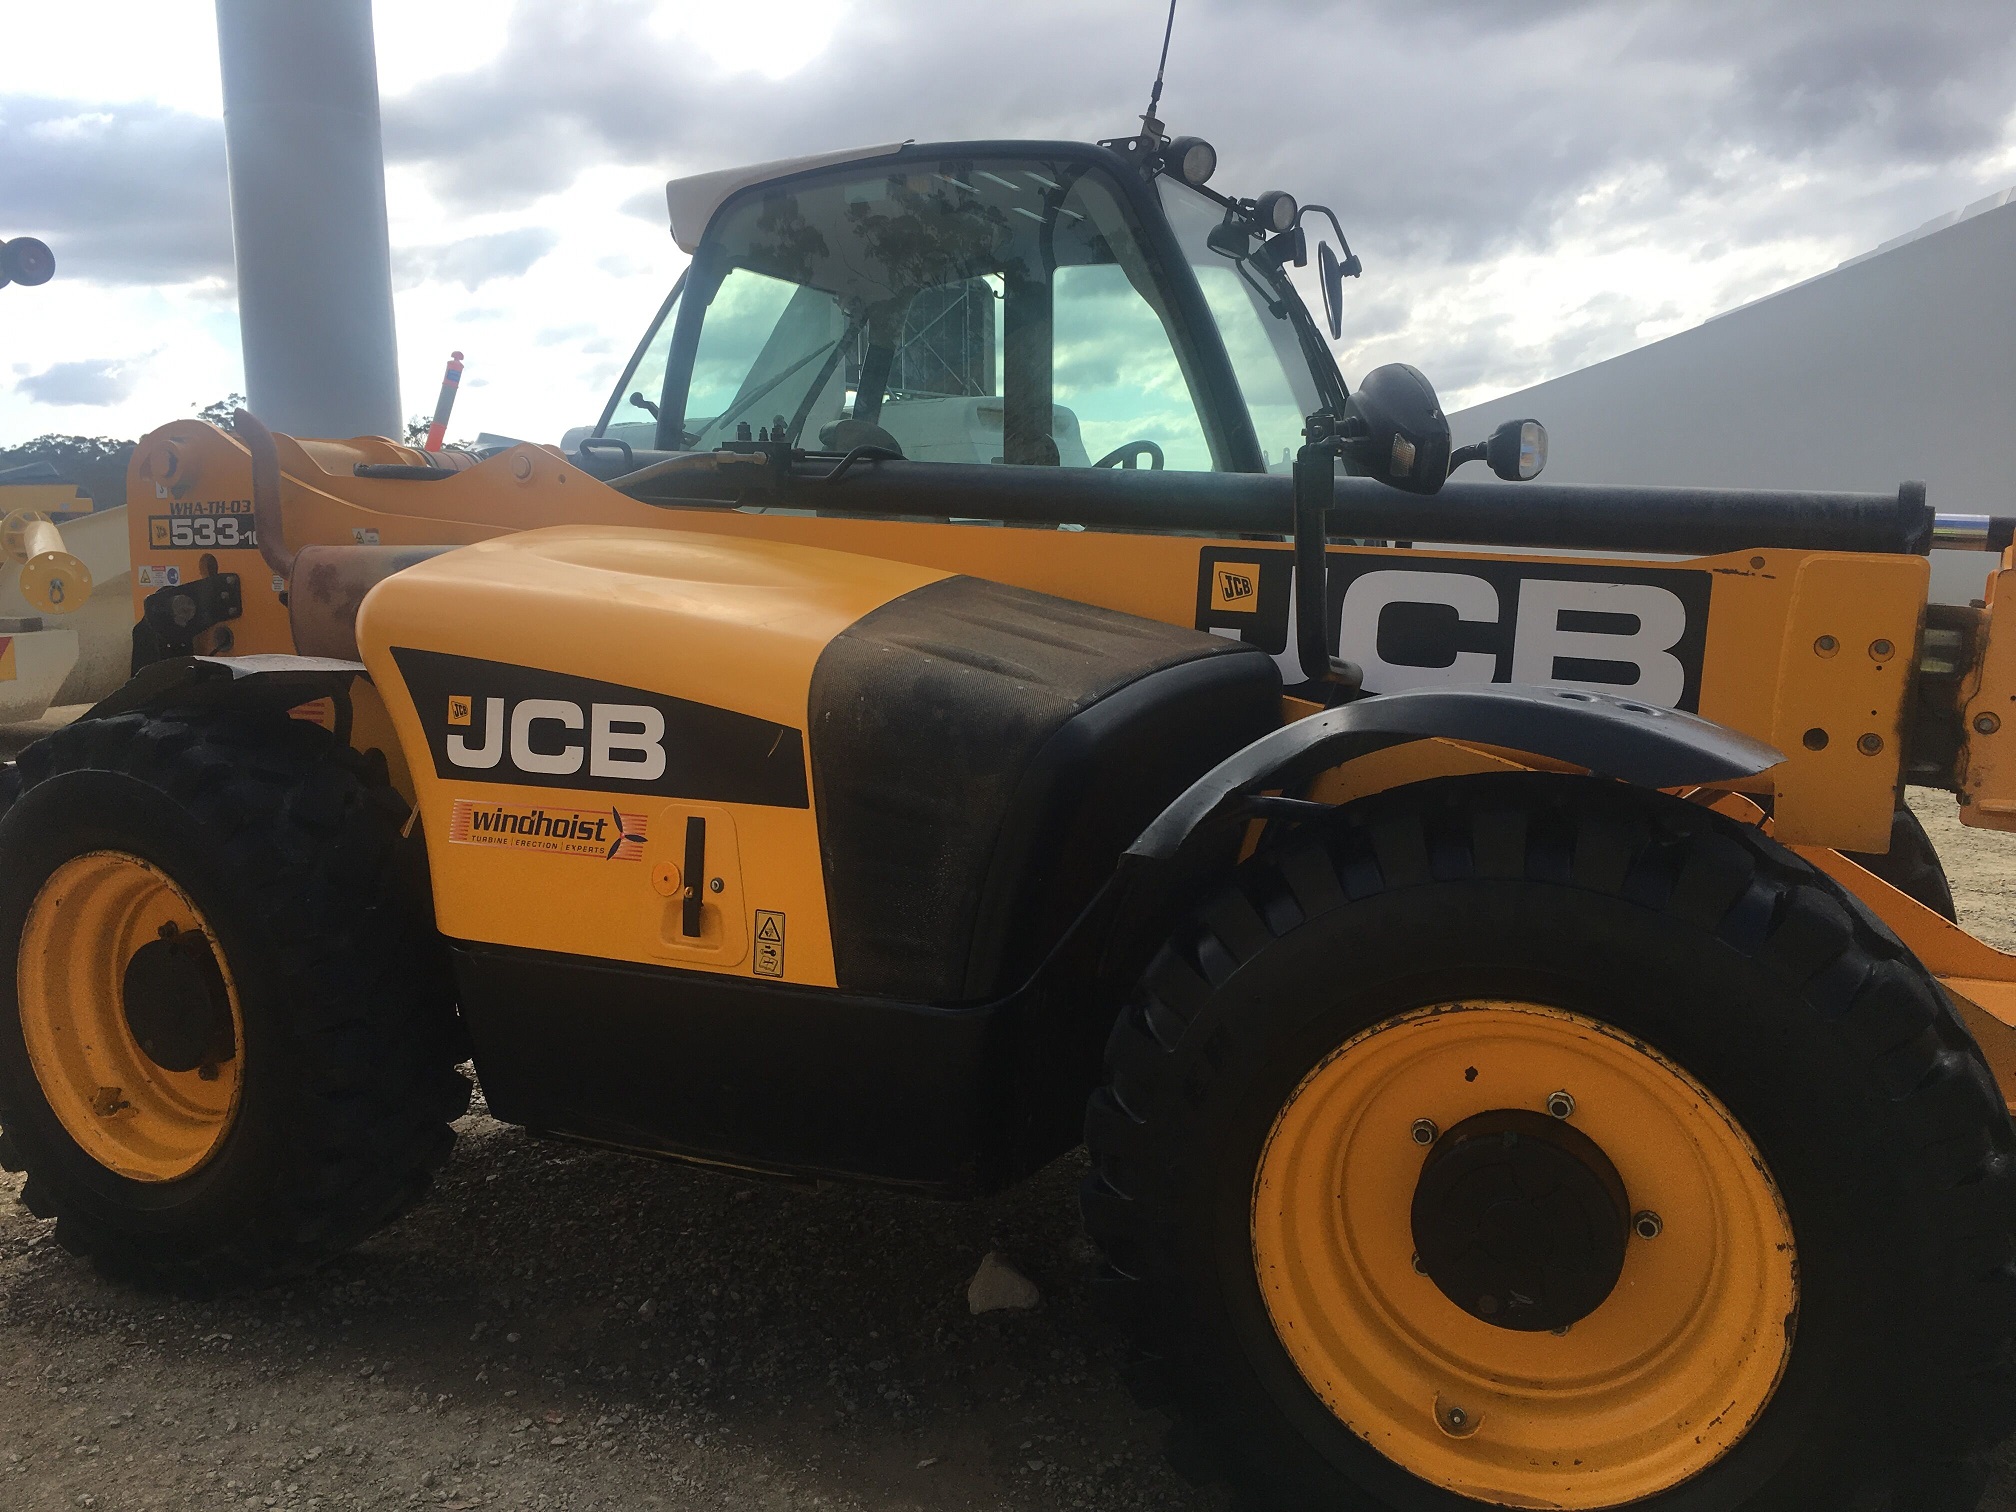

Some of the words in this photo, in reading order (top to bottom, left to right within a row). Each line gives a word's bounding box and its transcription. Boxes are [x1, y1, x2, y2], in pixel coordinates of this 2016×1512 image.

[170, 500, 251, 515] WHA-TH-03
[1225, 576, 1251, 599] JCB
[454, 703, 468, 717] JCB
[447, 698, 666, 780] JCB
[473, 807, 608, 842] windhoist
[471, 835, 508, 845] TURBINE
[515, 839, 558, 850] ERECTION
[565, 844, 605, 855] EXPERTS
